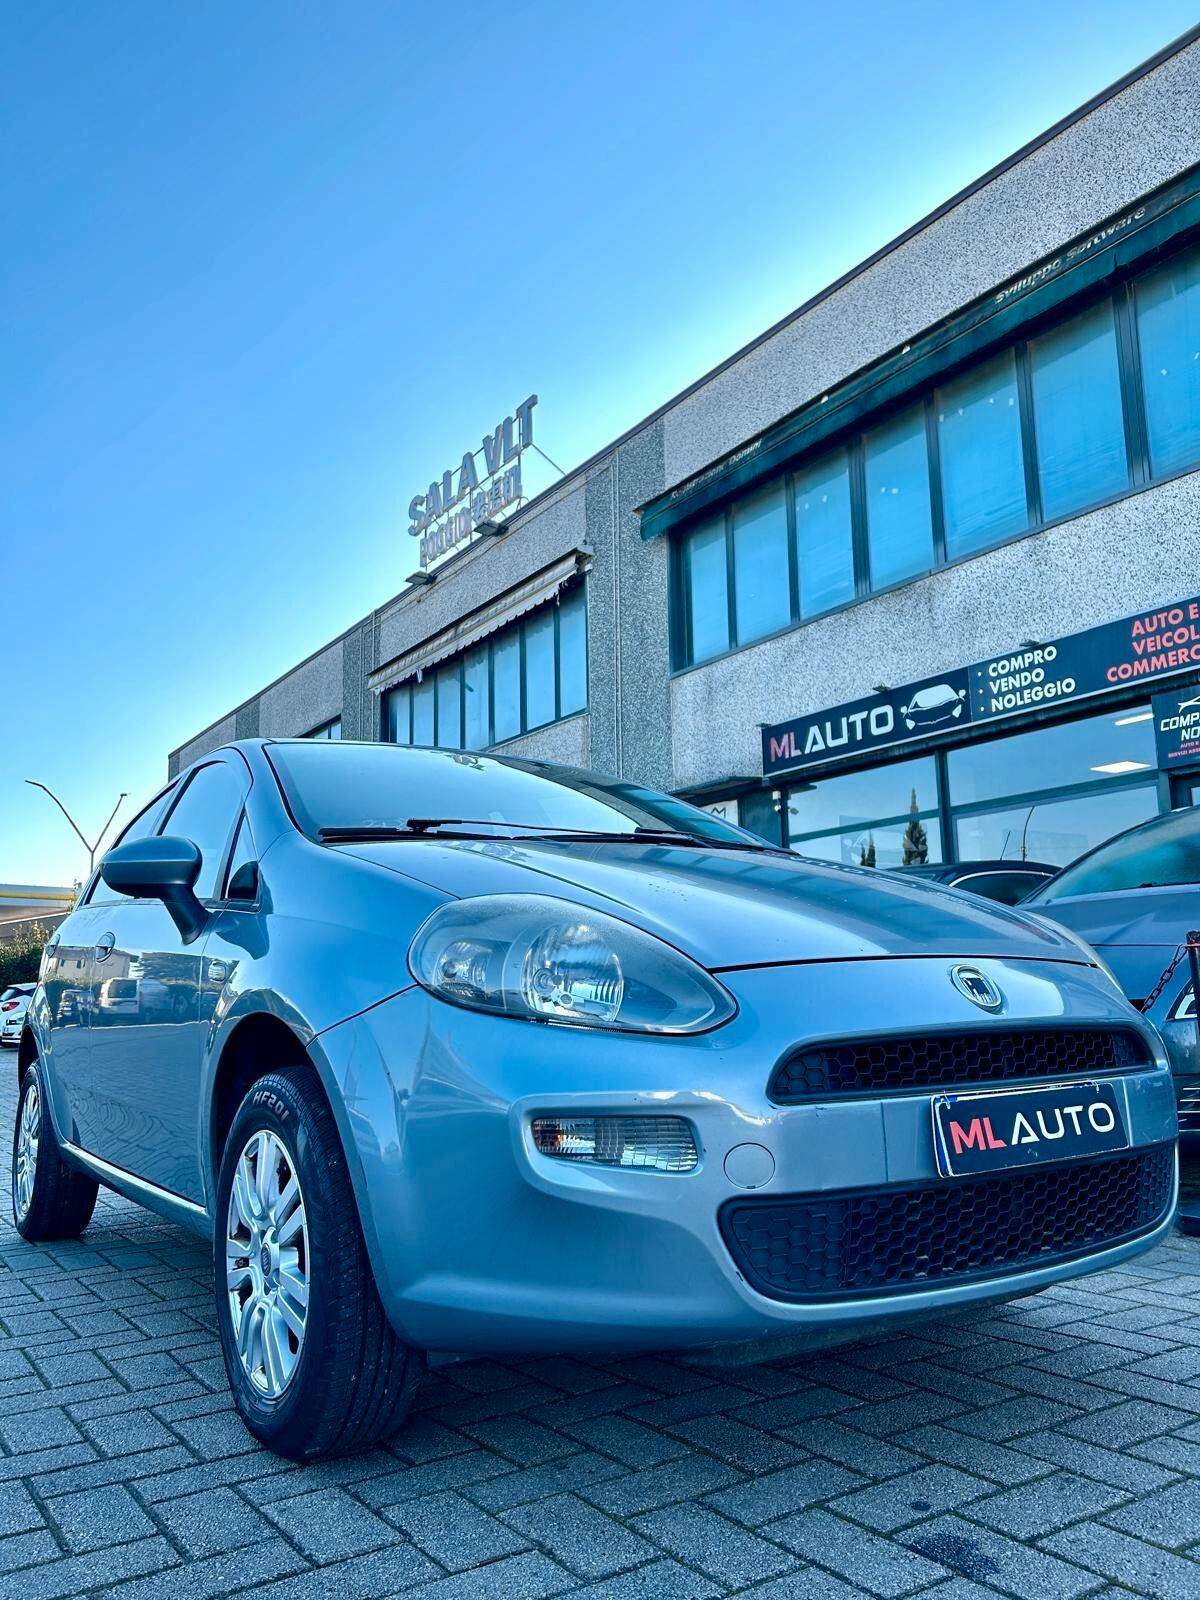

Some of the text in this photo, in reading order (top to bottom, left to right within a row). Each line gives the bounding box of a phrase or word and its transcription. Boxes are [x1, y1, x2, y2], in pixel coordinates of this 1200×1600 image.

[995, 258, 1062, 304] Sviluppo
[408, 451, 478, 537] SALA
[482, 393, 538, 477] VLT
[1131, 602, 1199, 638] AUTO E
[1131, 624, 1200, 656] VEICOL
[988, 645, 1058, 678] COMPRO
[1106, 643, 1200, 682] COMMERC
[989, 667, 1045, 695] VENDO
[991, 677, 1076, 713] NOLEGGIO
[769, 704, 895, 763] ML AUTO
[1161, 712, 1200, 731] COMP
[253, 1091, 289, 1120] HF201
[949, 1102, 1115, 1154] ML AUTO
